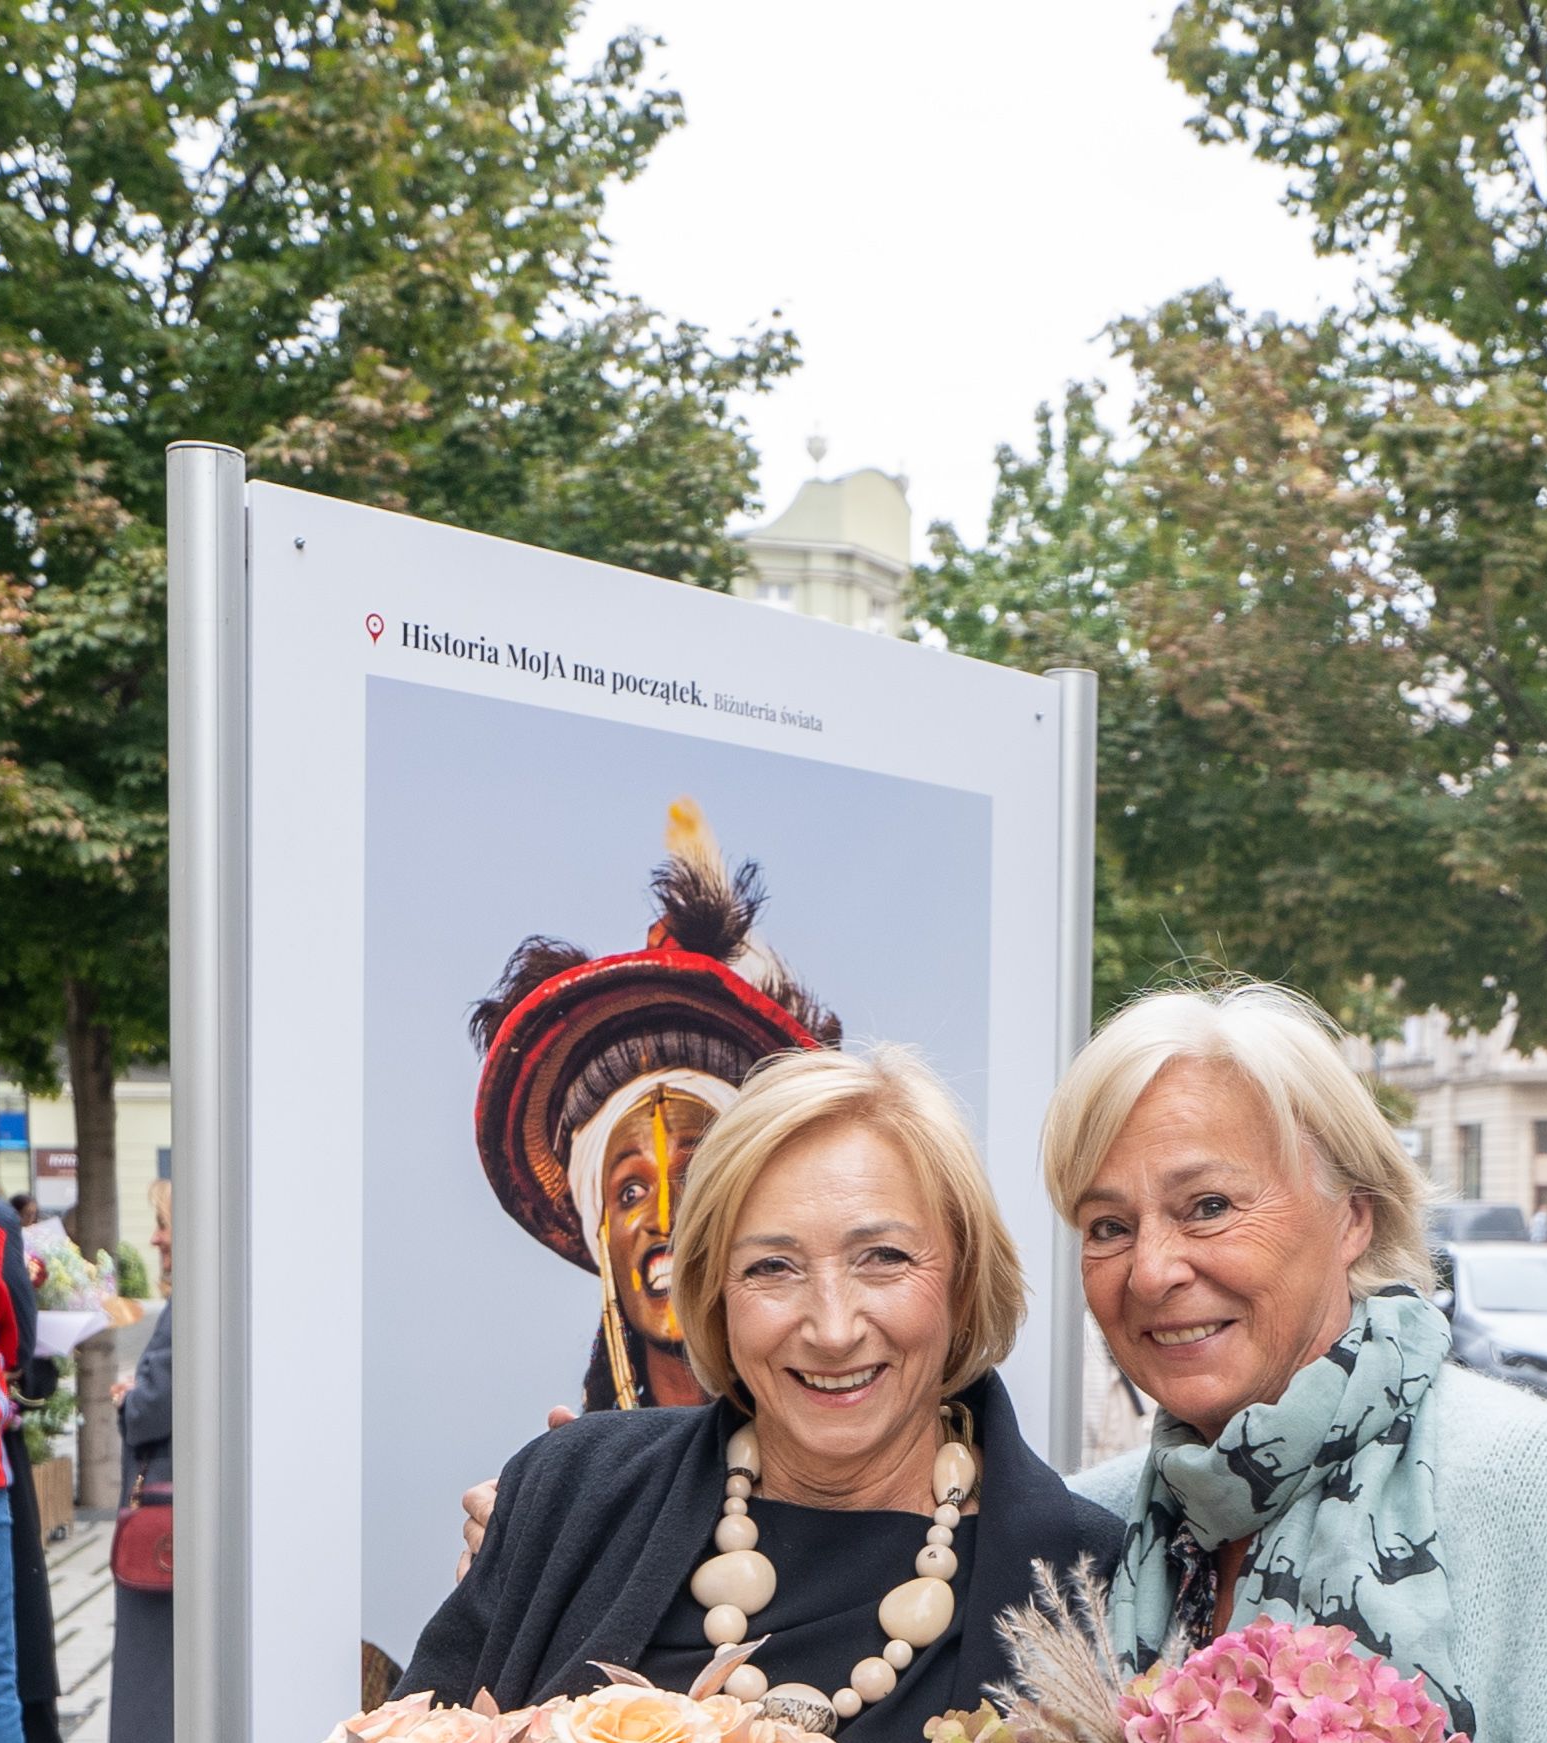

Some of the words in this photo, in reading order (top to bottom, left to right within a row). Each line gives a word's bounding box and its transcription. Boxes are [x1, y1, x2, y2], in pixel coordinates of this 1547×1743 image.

[401, 621, 500, 666] Historia
[506, 643, 567, 681] MoJA
[572, 662, 605, 687] ma
[611, 671, 708, 708] początek.
[713, 692, 777, 723] Biżuteria
[780, 705, 823, 732] świata
